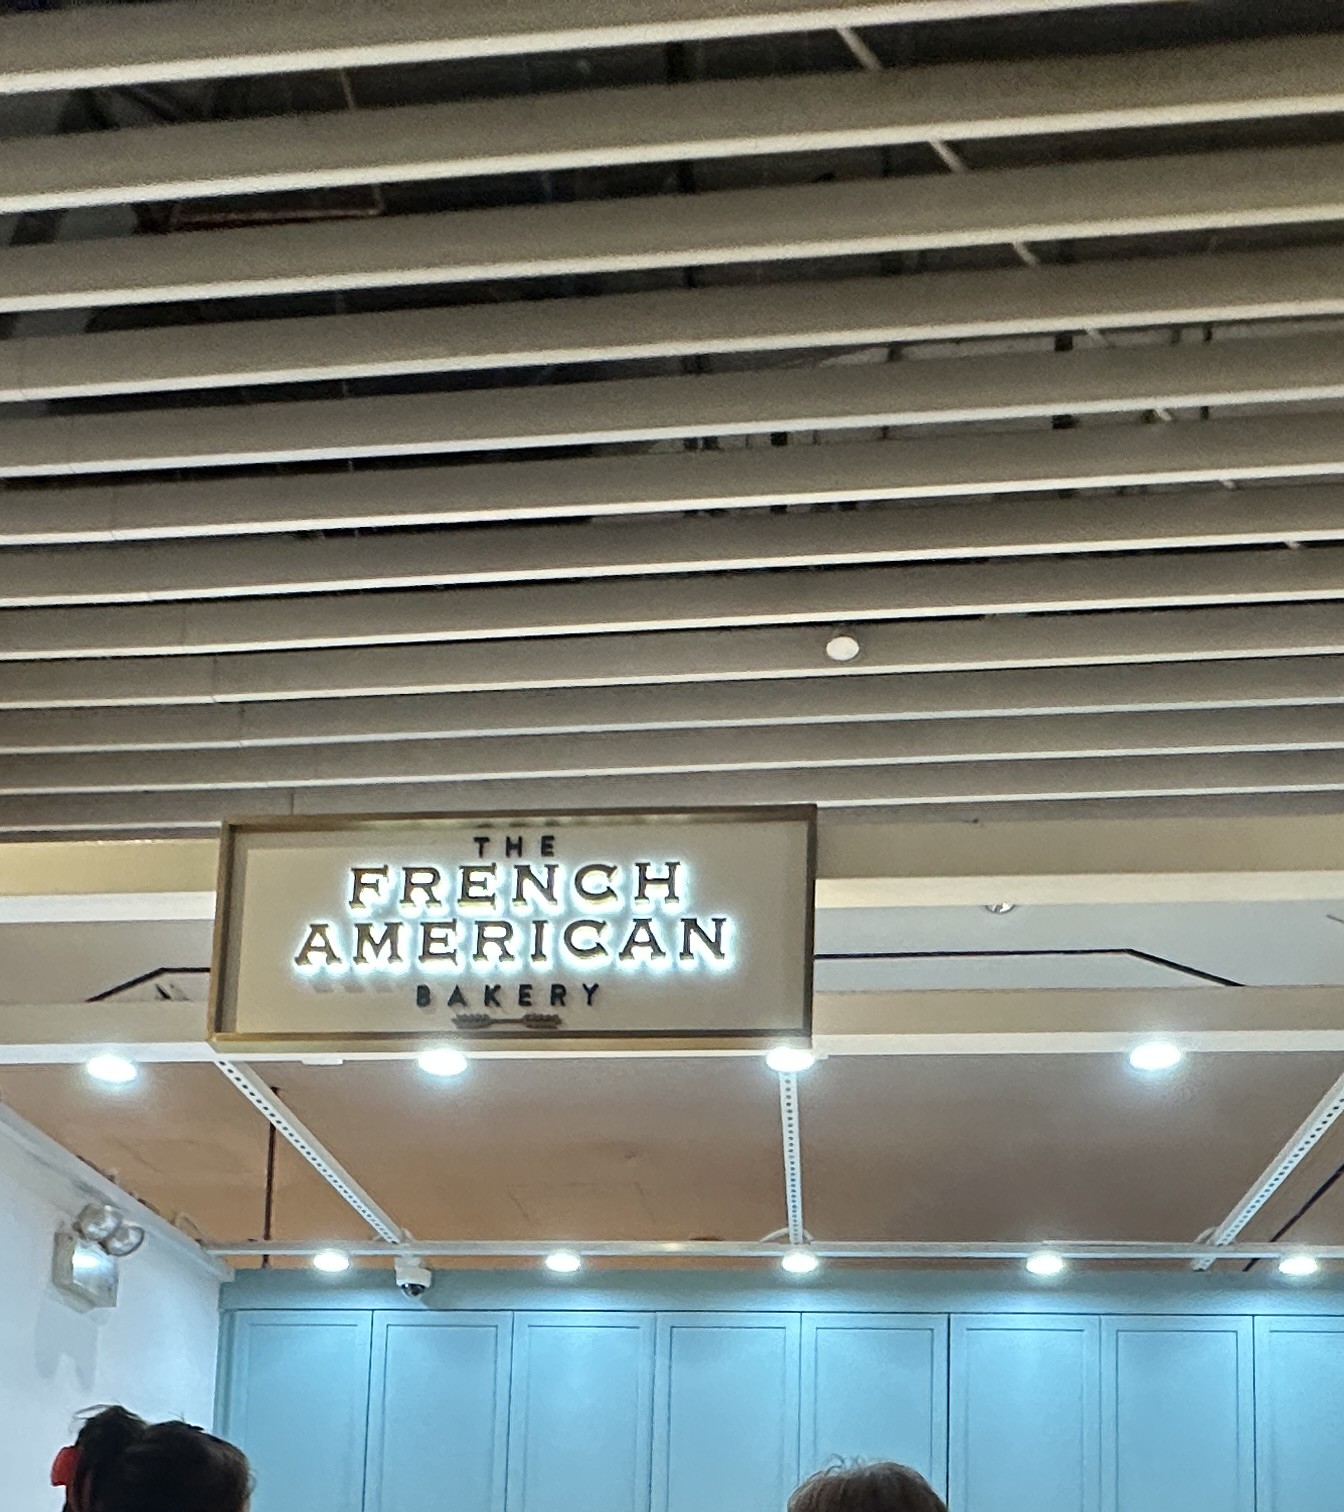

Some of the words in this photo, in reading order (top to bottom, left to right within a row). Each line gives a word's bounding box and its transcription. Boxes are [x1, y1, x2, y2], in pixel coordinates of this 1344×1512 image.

[473, 834, 556, 859] THE
[348, 859, 683, 909] FRENCH
[293, 916, 730, 968] AMERICAN
[415, 983, 602, 1009] BAKERY
